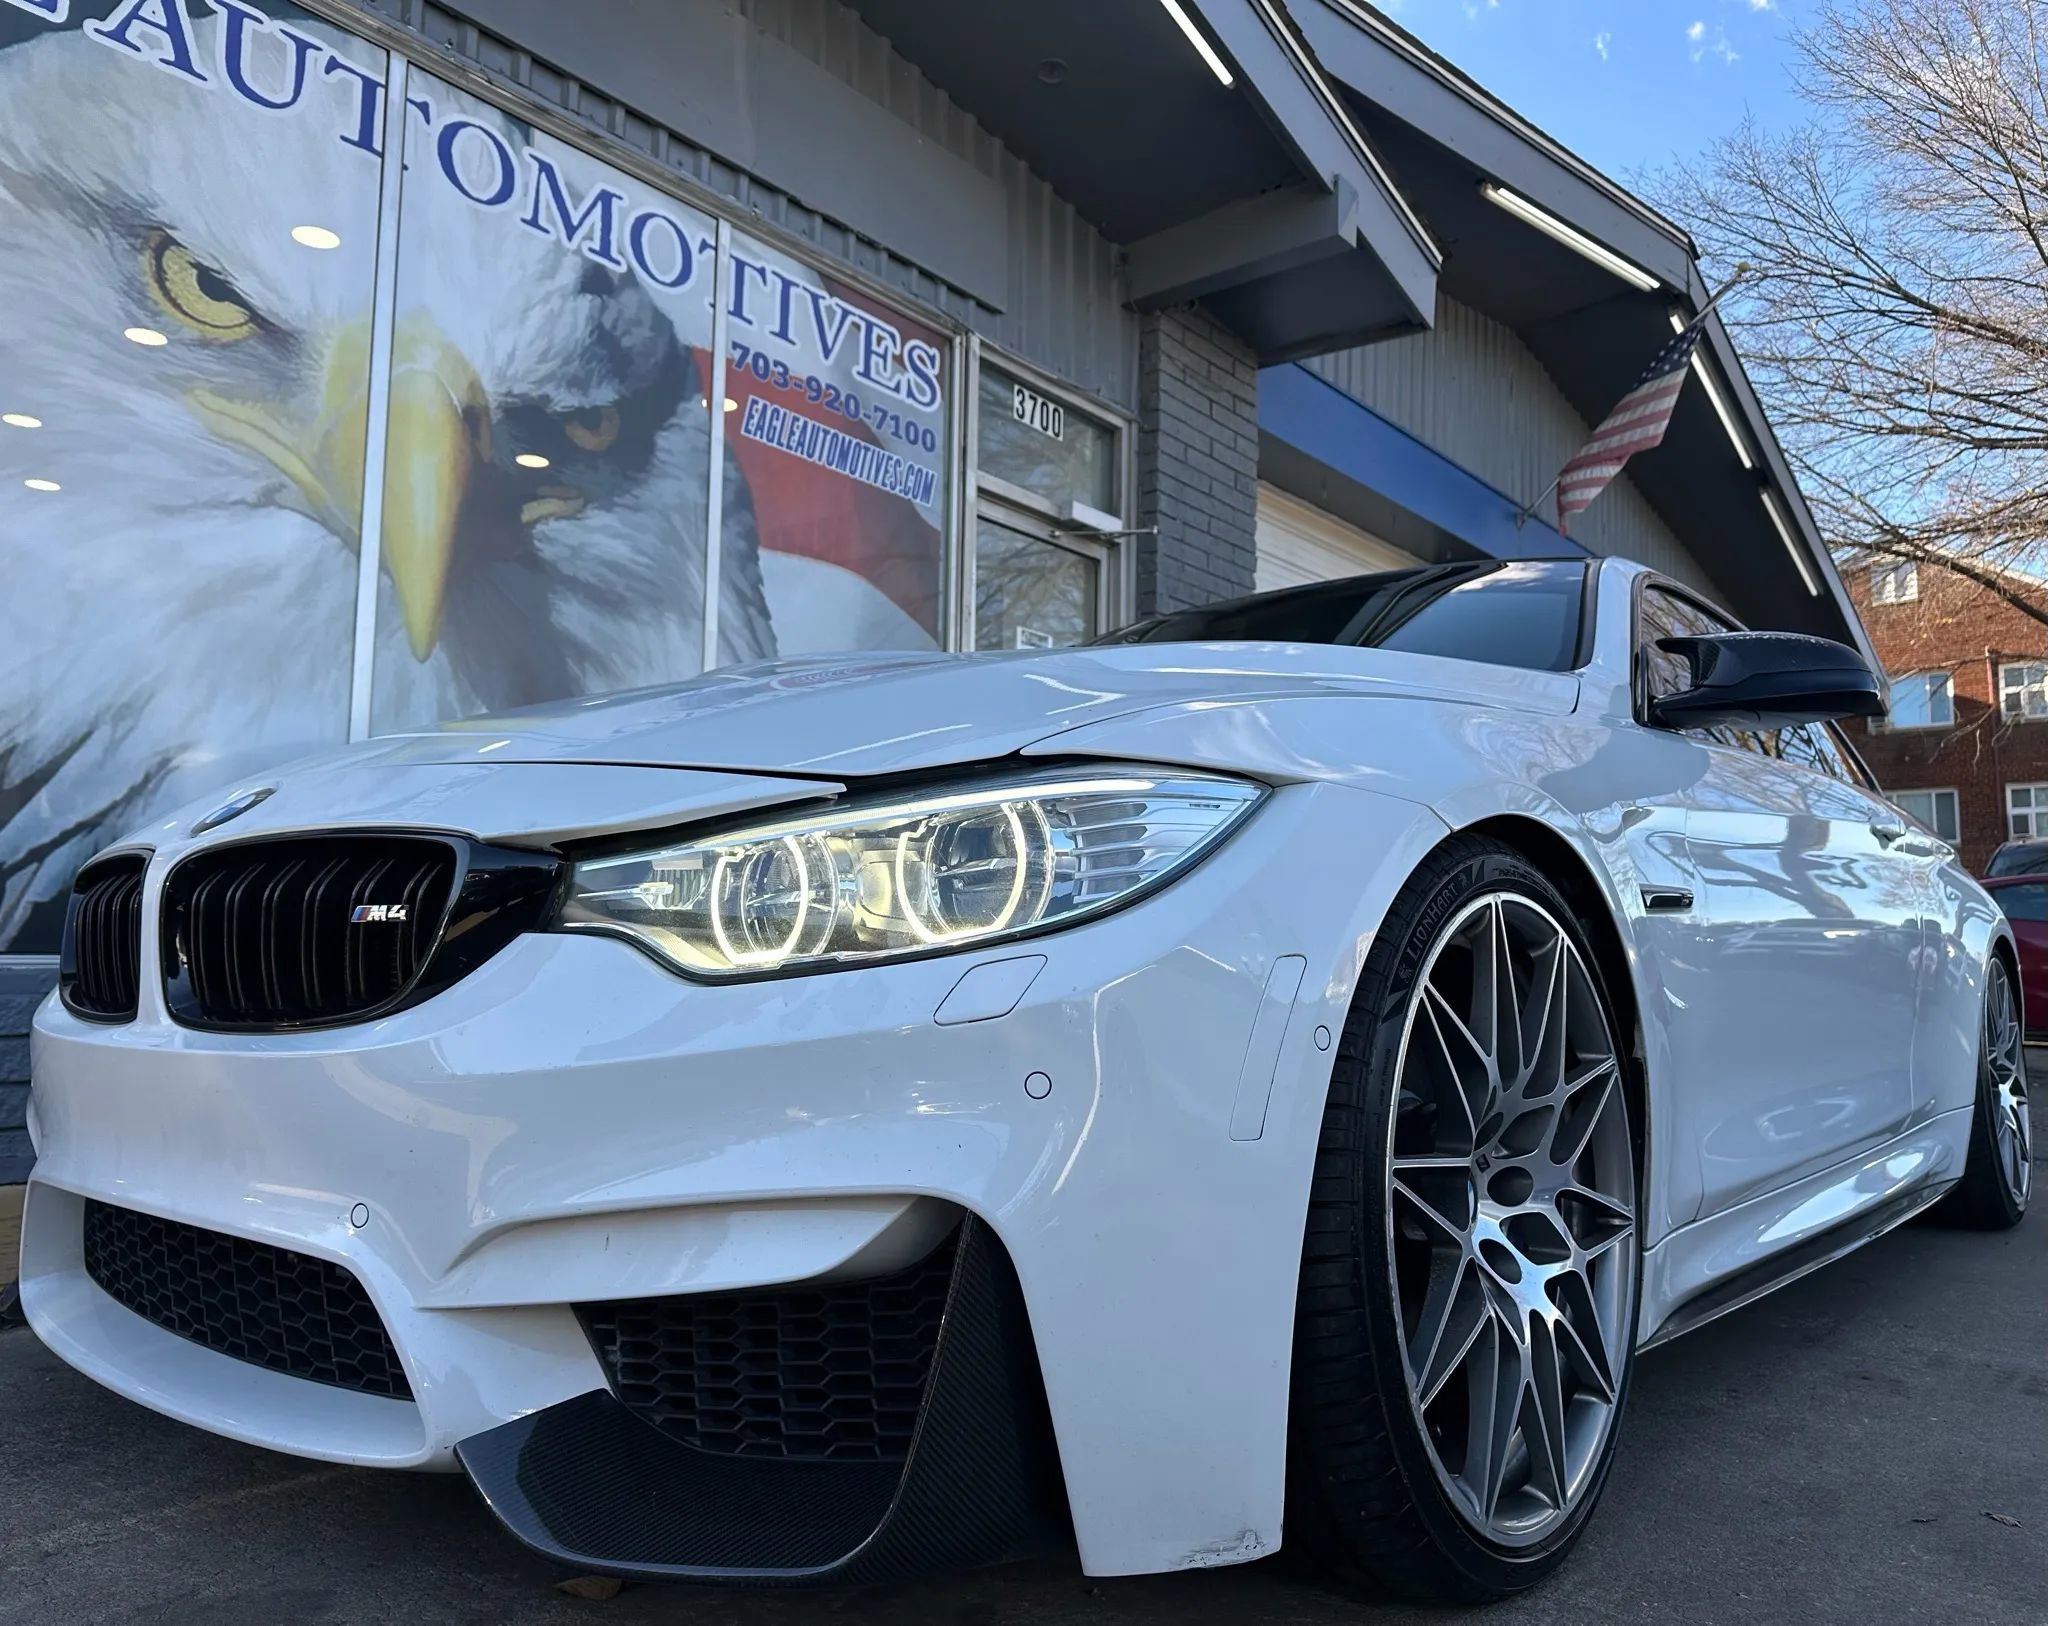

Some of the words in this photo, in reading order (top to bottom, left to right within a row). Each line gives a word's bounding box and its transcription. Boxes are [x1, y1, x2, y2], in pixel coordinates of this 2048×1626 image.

[92, 0, 939, 407] AUTOMOTIVES
[731, 340, 936, 453] 703-920-7100
[1016, 387, 1061, 438] 3700
[742, 397, 935, 505] EAGLEAUTOMOTIVES.COM
[366, 904, 406, 921] M4
[1406, 882, 1459, 961] LIONHART
